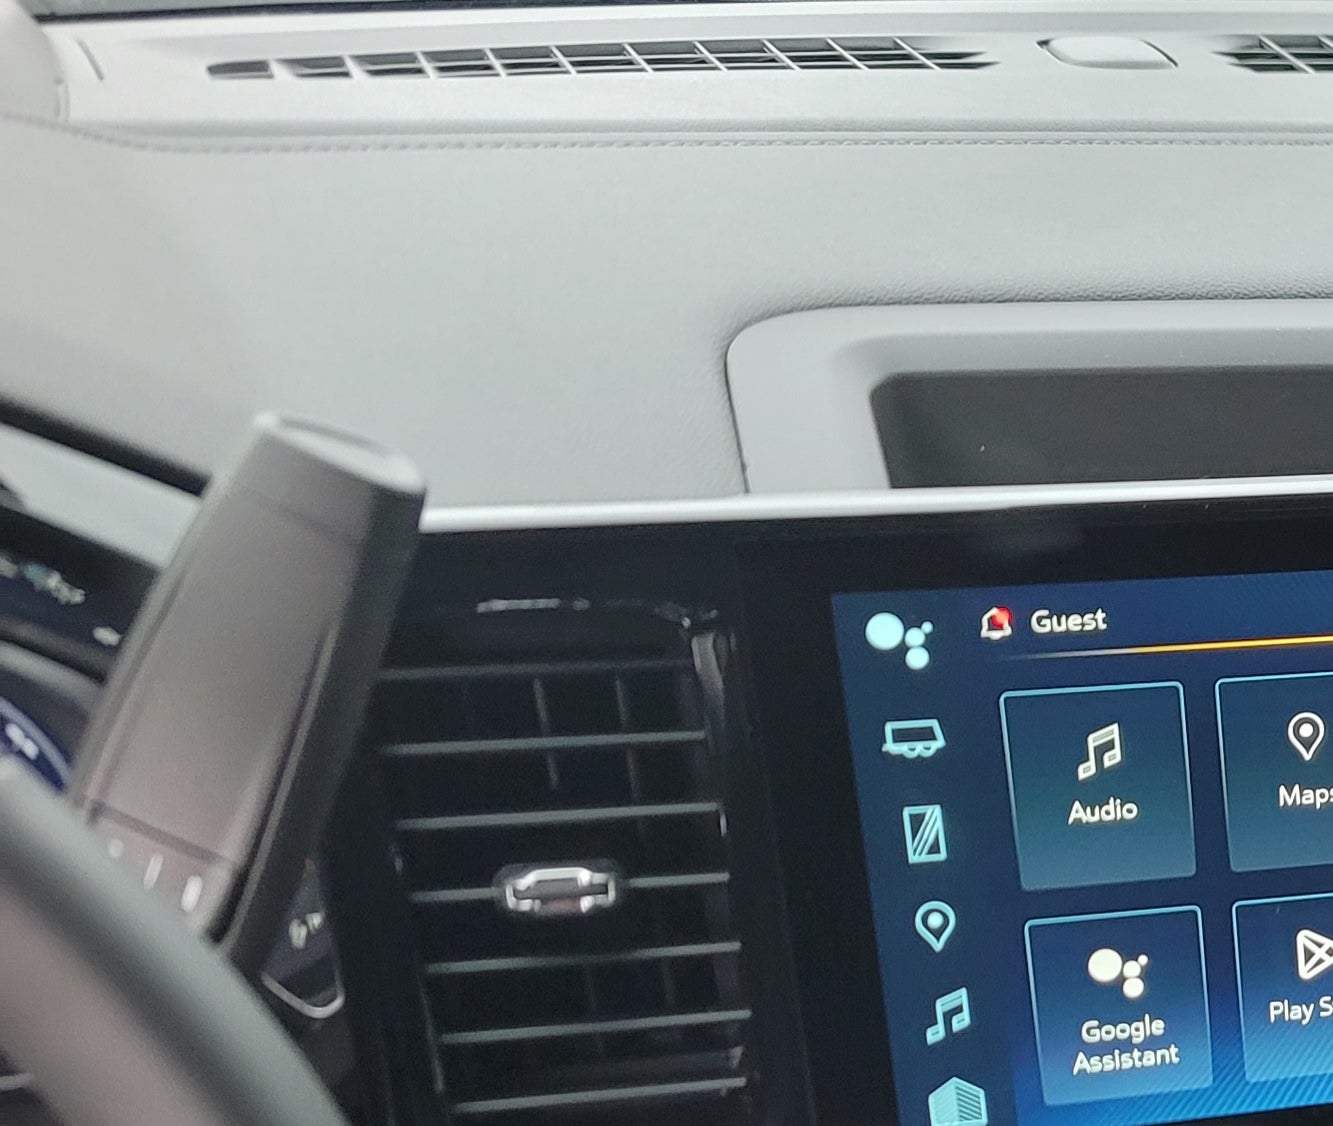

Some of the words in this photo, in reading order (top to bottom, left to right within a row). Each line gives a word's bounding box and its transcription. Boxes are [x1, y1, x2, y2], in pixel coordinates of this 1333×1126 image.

[1031, 608, 1108, 633] Guest
[1067, 796, 1139, 825] Audio
[1268, 999, 1314, 1026] Play
[1080, 1013, 1166, 1044] Google
[1072, 1043, 1180, 1076] Assistant
